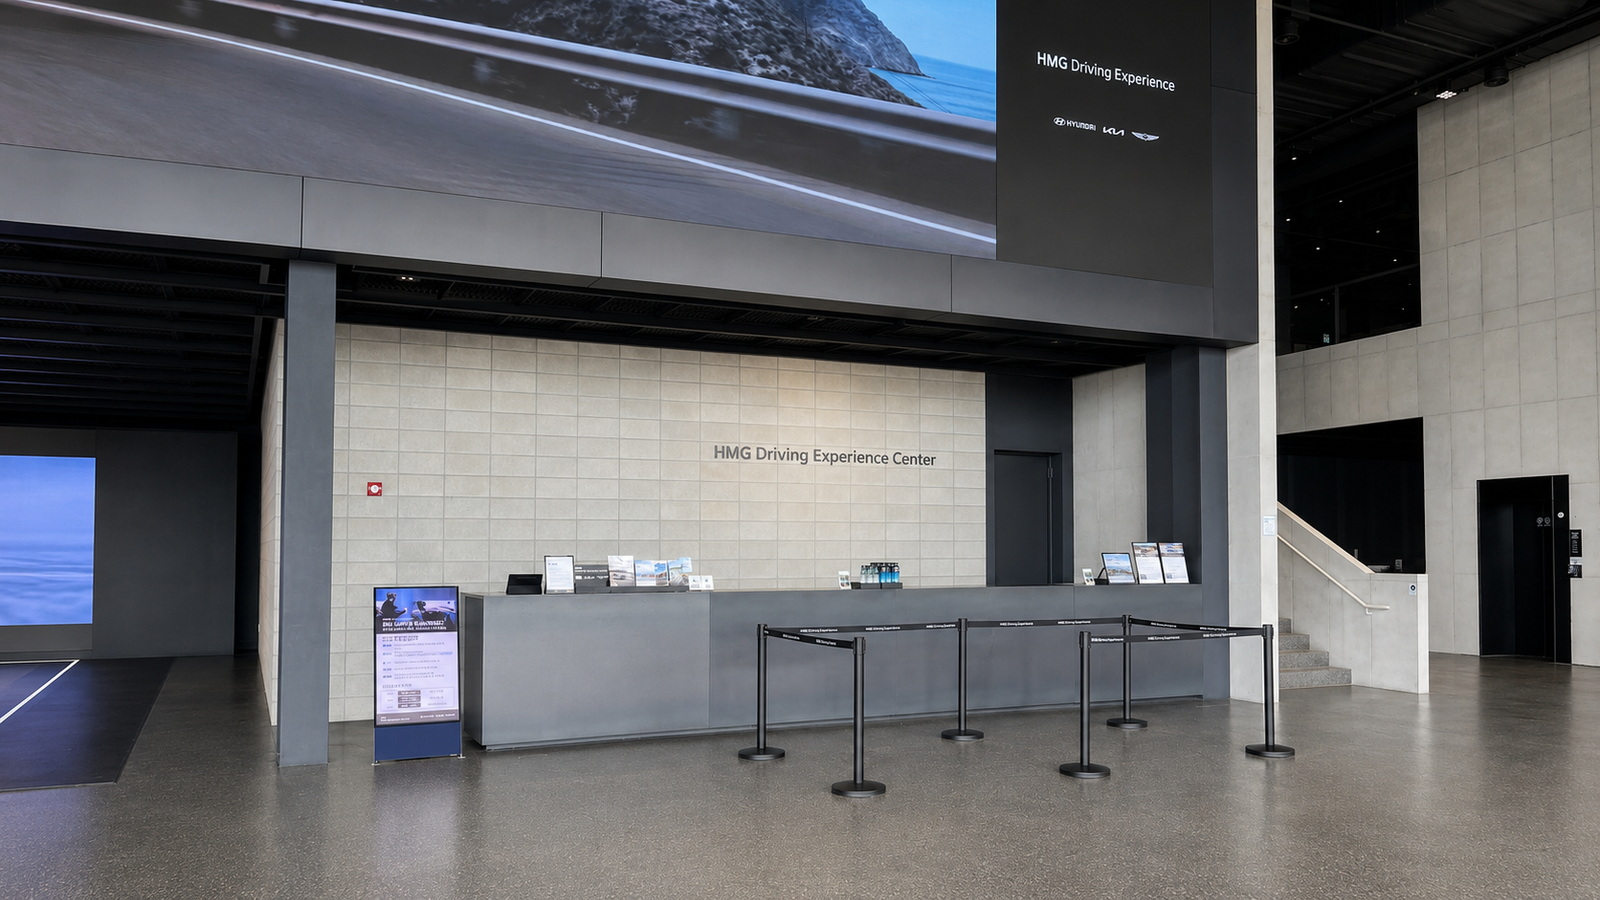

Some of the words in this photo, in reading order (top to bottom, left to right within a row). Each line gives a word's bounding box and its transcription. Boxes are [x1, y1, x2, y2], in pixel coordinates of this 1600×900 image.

[1038, 52, 1067, 69] HMG
[1072, 59, 1111, 81] Driving
[1115, 68, 1175, 91] Experience
[1067, 120, 1096, 131] HYUNDAI
[715, 446, 751, 459] HMG
[757, 447, 808, 465] Driving
[814, 449, 888, 465] Experience
[893, 452, 936, 465] Center
